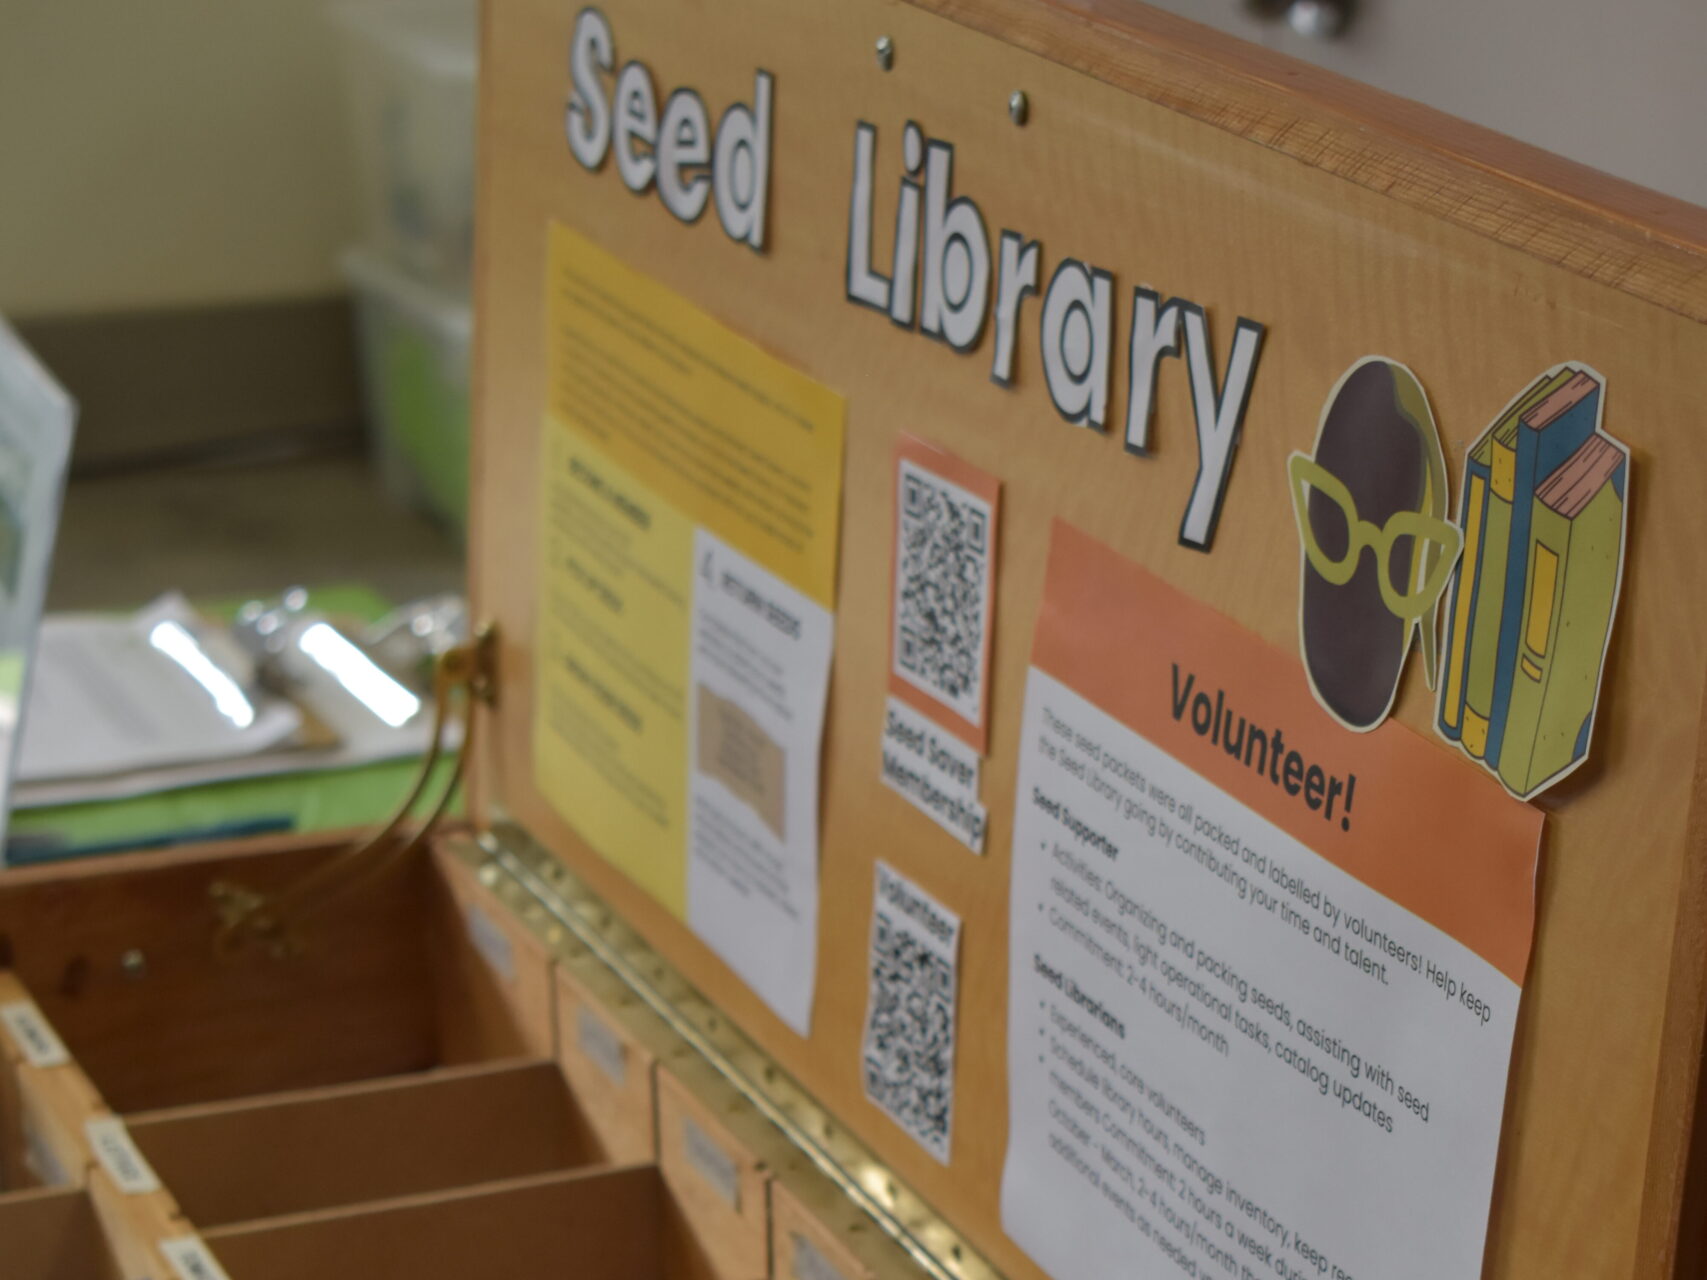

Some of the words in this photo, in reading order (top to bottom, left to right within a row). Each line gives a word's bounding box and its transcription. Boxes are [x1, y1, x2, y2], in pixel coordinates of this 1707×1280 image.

[565, 5, 776, 254] Seed
[845, 118, 1266, 553] Library
[886, 711, 926, 757] Seed
[929, 737, 975, 788] Saver
[1170, 662, 1357, 832] Volunteer!
[883, 751, 983, 848] Membership
[1033, 785, 1060, 821] Seed
[1060, 806, 1119, 862] Supporter
[879, 869, 955, 945] Volunteer
[1039, 733, 1057, 762] the
[1058, 748, 1085, 781] Seed
[1086, 769, 1123, 811] Library
[1123, 798, 1156, 837] going
[1158, 820, 1174, 848] by
[1175, 832, 1247, 900] contributing
[1249, 883, 1279, 914] your
[1280, 901, 1310, 936] time
[1313, 926, 1341, 955] and
[1344, 941, 1389, 985] talent.
[1043, 706, 1073, 742] These
[1074, 732, 1101, 762] seed
[1101, 752, 1146, 793] packets
[1149, 782, 1177, 813] were
[1177, 800, 1194, 825] all
[1193, 814, 1240, 856] packed
[1241, 846, 1267, 874] and
[1268, 860, 1321, 910] labelled
[1322, 895, 1341, 928] by
[1343, 911, 1424, 974] volunteers!
[1426, 960, 1457, 1001] Help
[1459, 981, 1491, 1027] keep
[1033, 953, 1063, 990] Seed
[1064, 978, 1126, 1040] Librarians
[1050, 877, 1090, 917] related
[1133, 933, 1160, 970] light
[1160, 959, 1232, 1021] operational
[1234, 1010, 1273, 1053] tasks,
[1274, 1041, 1330, 1096] catalog
[1332, 1079, 1394, 1134] updates
[1104, 880, 1167, 947] Organizing
[1169, 930, 1195, 960] and
[1196, 949, 1248, 1004] packing
[1250, 987, 1295, 1032] seeds,
[1296, 1018, 1361, 1079] assisting
[1364, 1060, 1395, 1096] with
[1397, 1085, 1430, 1125] seed
[1149, 984, 1230, 1058] hours/month
[1119, 1063, 1145, 1095] core
[1147, 1085, 1207, 1147] volunteers
[1050, 1036, 1101, 1090] Schedule
[1101, 1076, 1137, 1126] library
[1172, 1142, 1225, 1196] manage
[1225, 1180, 1292, 1249] inventory,
[1293, 1231, 1329, 1276] keep
[1101, 1180, 1137, 1224] events
[1136, 1213, 1152, 1239] as
[1152, 1228, 1198, 1278] needed
[1159, 1195, 1239, 1278] hours/month
[1177, 1178, 1188, 1200] 2
[1187, 1186, 1223, 1231] hours
[1223, 1220, 1235, 1239] a
[1236, 1228, 1272, 1268] week
